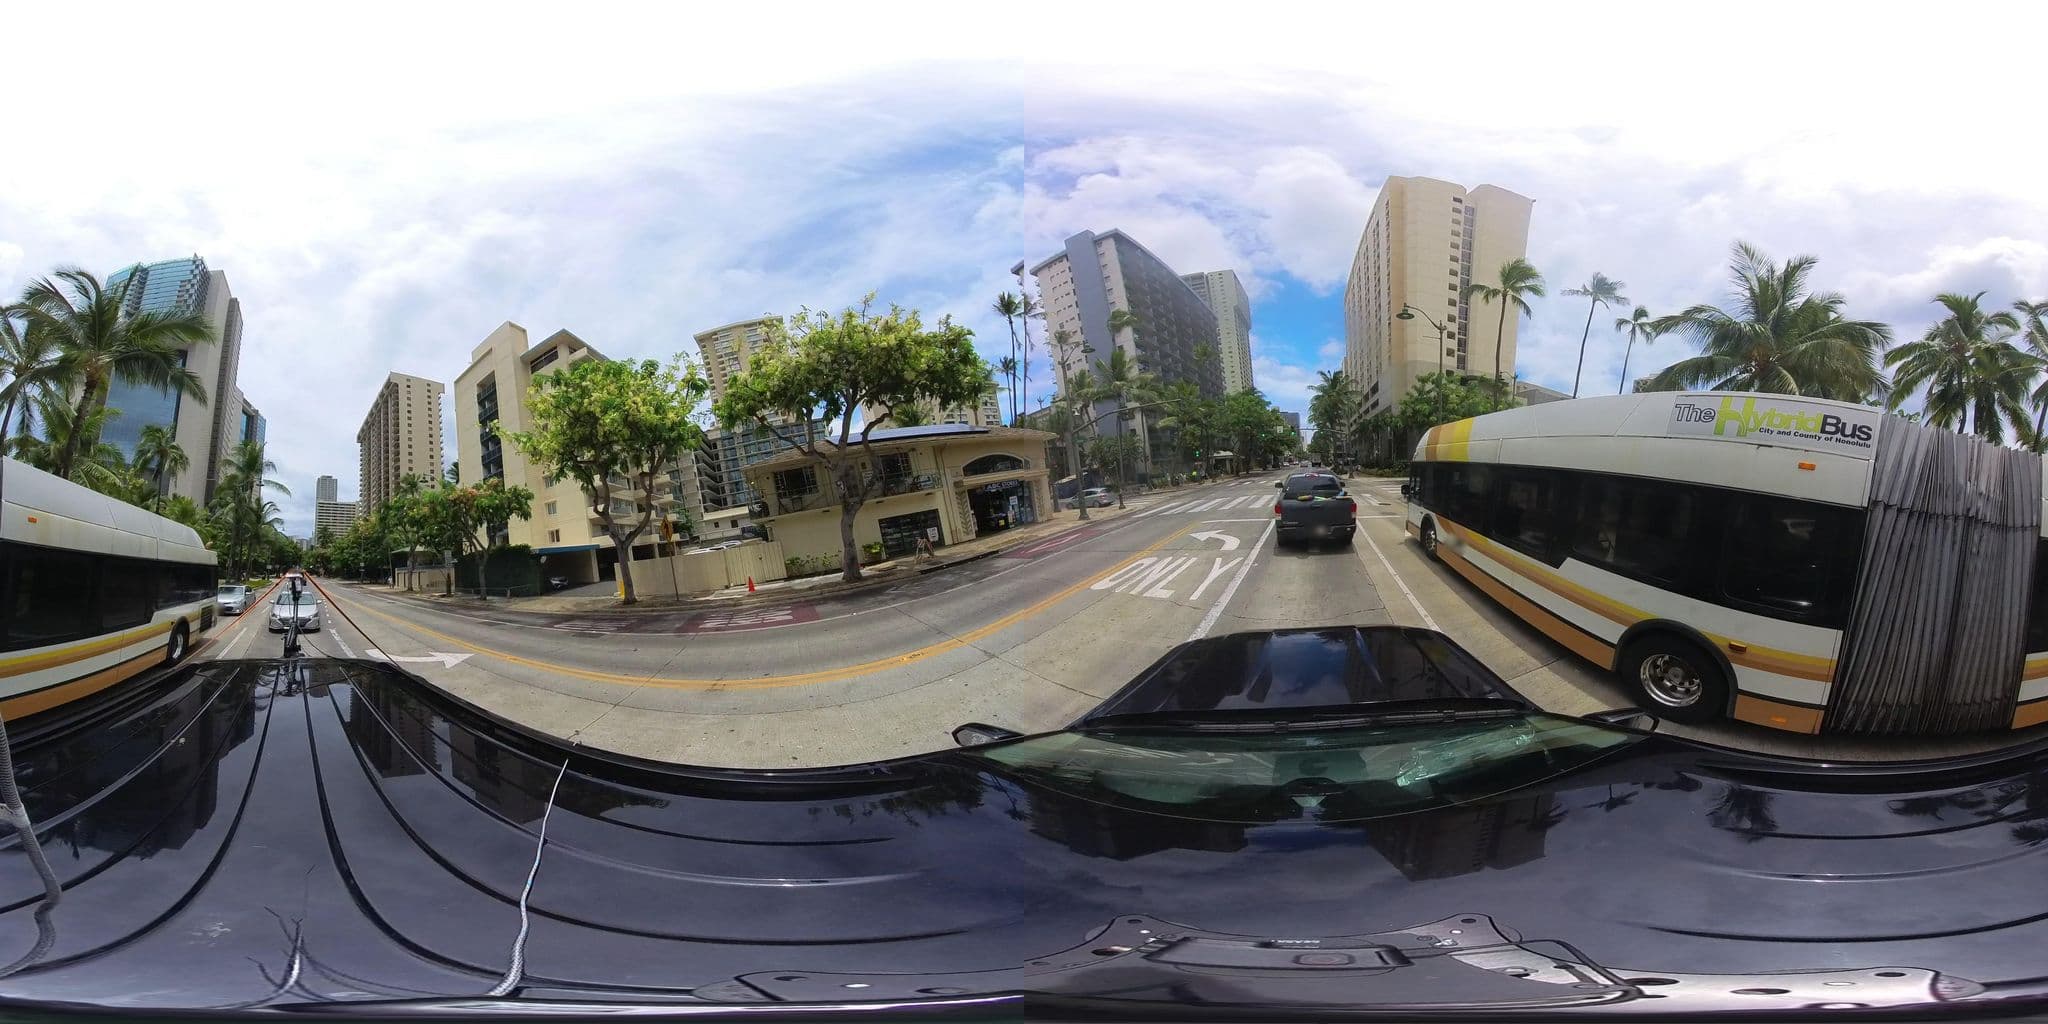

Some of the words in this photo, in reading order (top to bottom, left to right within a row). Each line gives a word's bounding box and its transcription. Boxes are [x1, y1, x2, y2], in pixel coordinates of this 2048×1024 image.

[1758, 427, 1775, 435] City
[1793, 431, 1822, 441] County
[1835, 437, 1871, 449] Honolulu
[1091, 556, 1244, 600] ONLY
